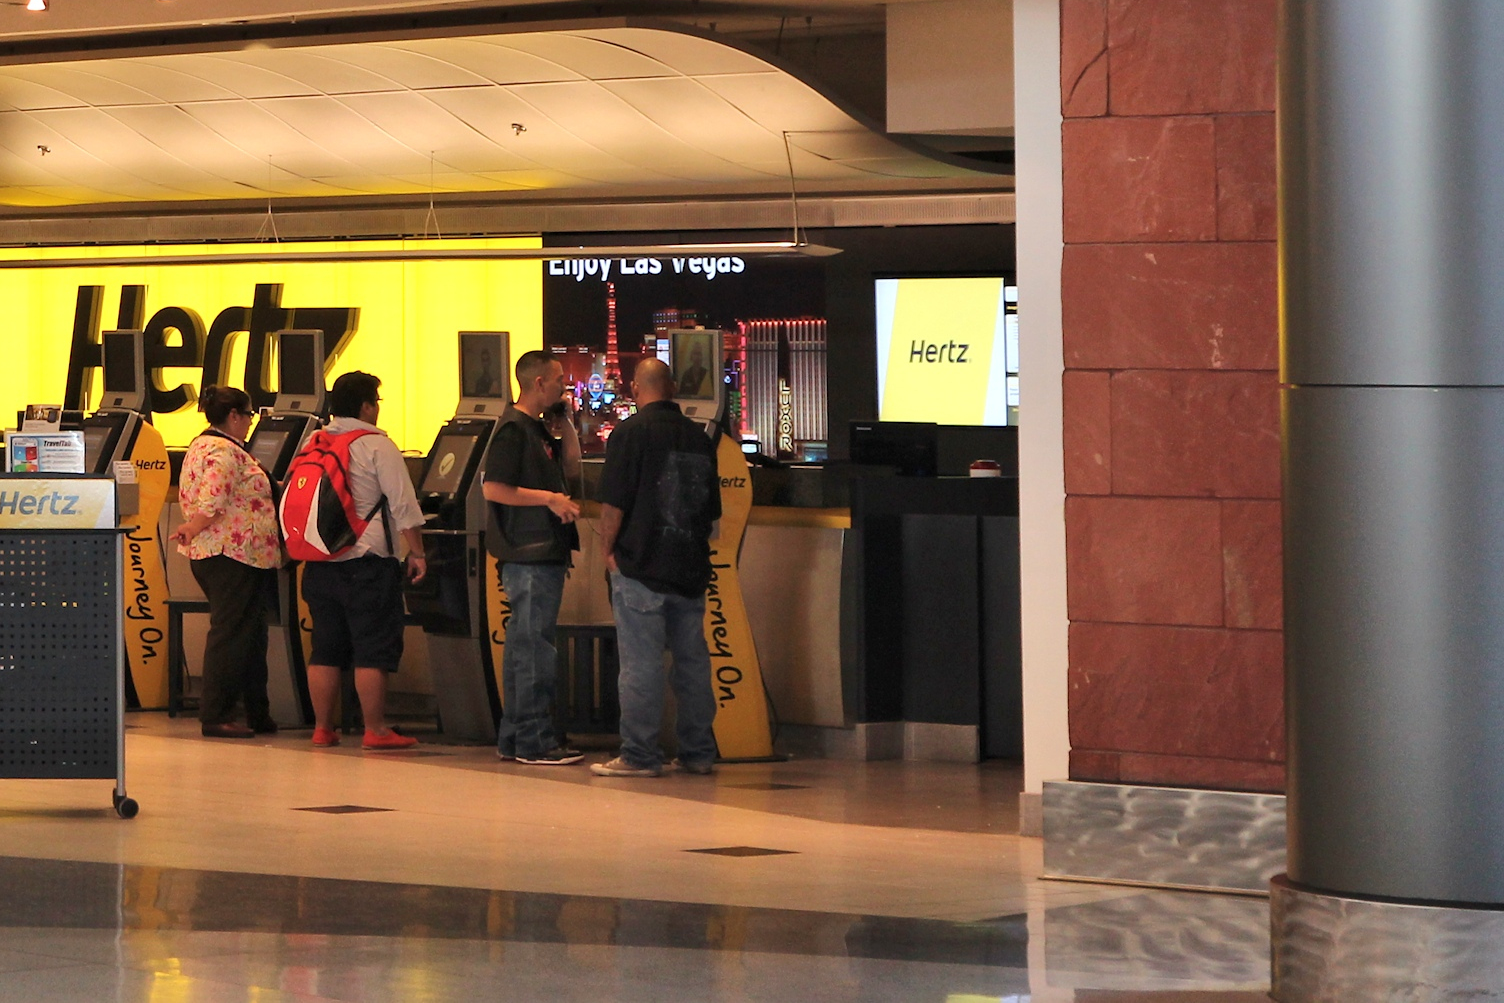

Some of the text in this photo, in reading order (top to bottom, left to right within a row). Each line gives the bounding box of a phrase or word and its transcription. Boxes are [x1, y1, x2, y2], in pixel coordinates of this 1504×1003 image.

[549, 256, 745, 282] Enjoy Las Vegas
[64, 283, 361, 413] Hertz
[909, 339, 969, 363] Hertz
[779, 378, 793, 452] LUXOR
[136, 459, 166, 470] Hertz
[719, 476, 747, 488] ertz
[126, 525, 164, 665] Journey On.
[715, 666, 743, 709] On.
